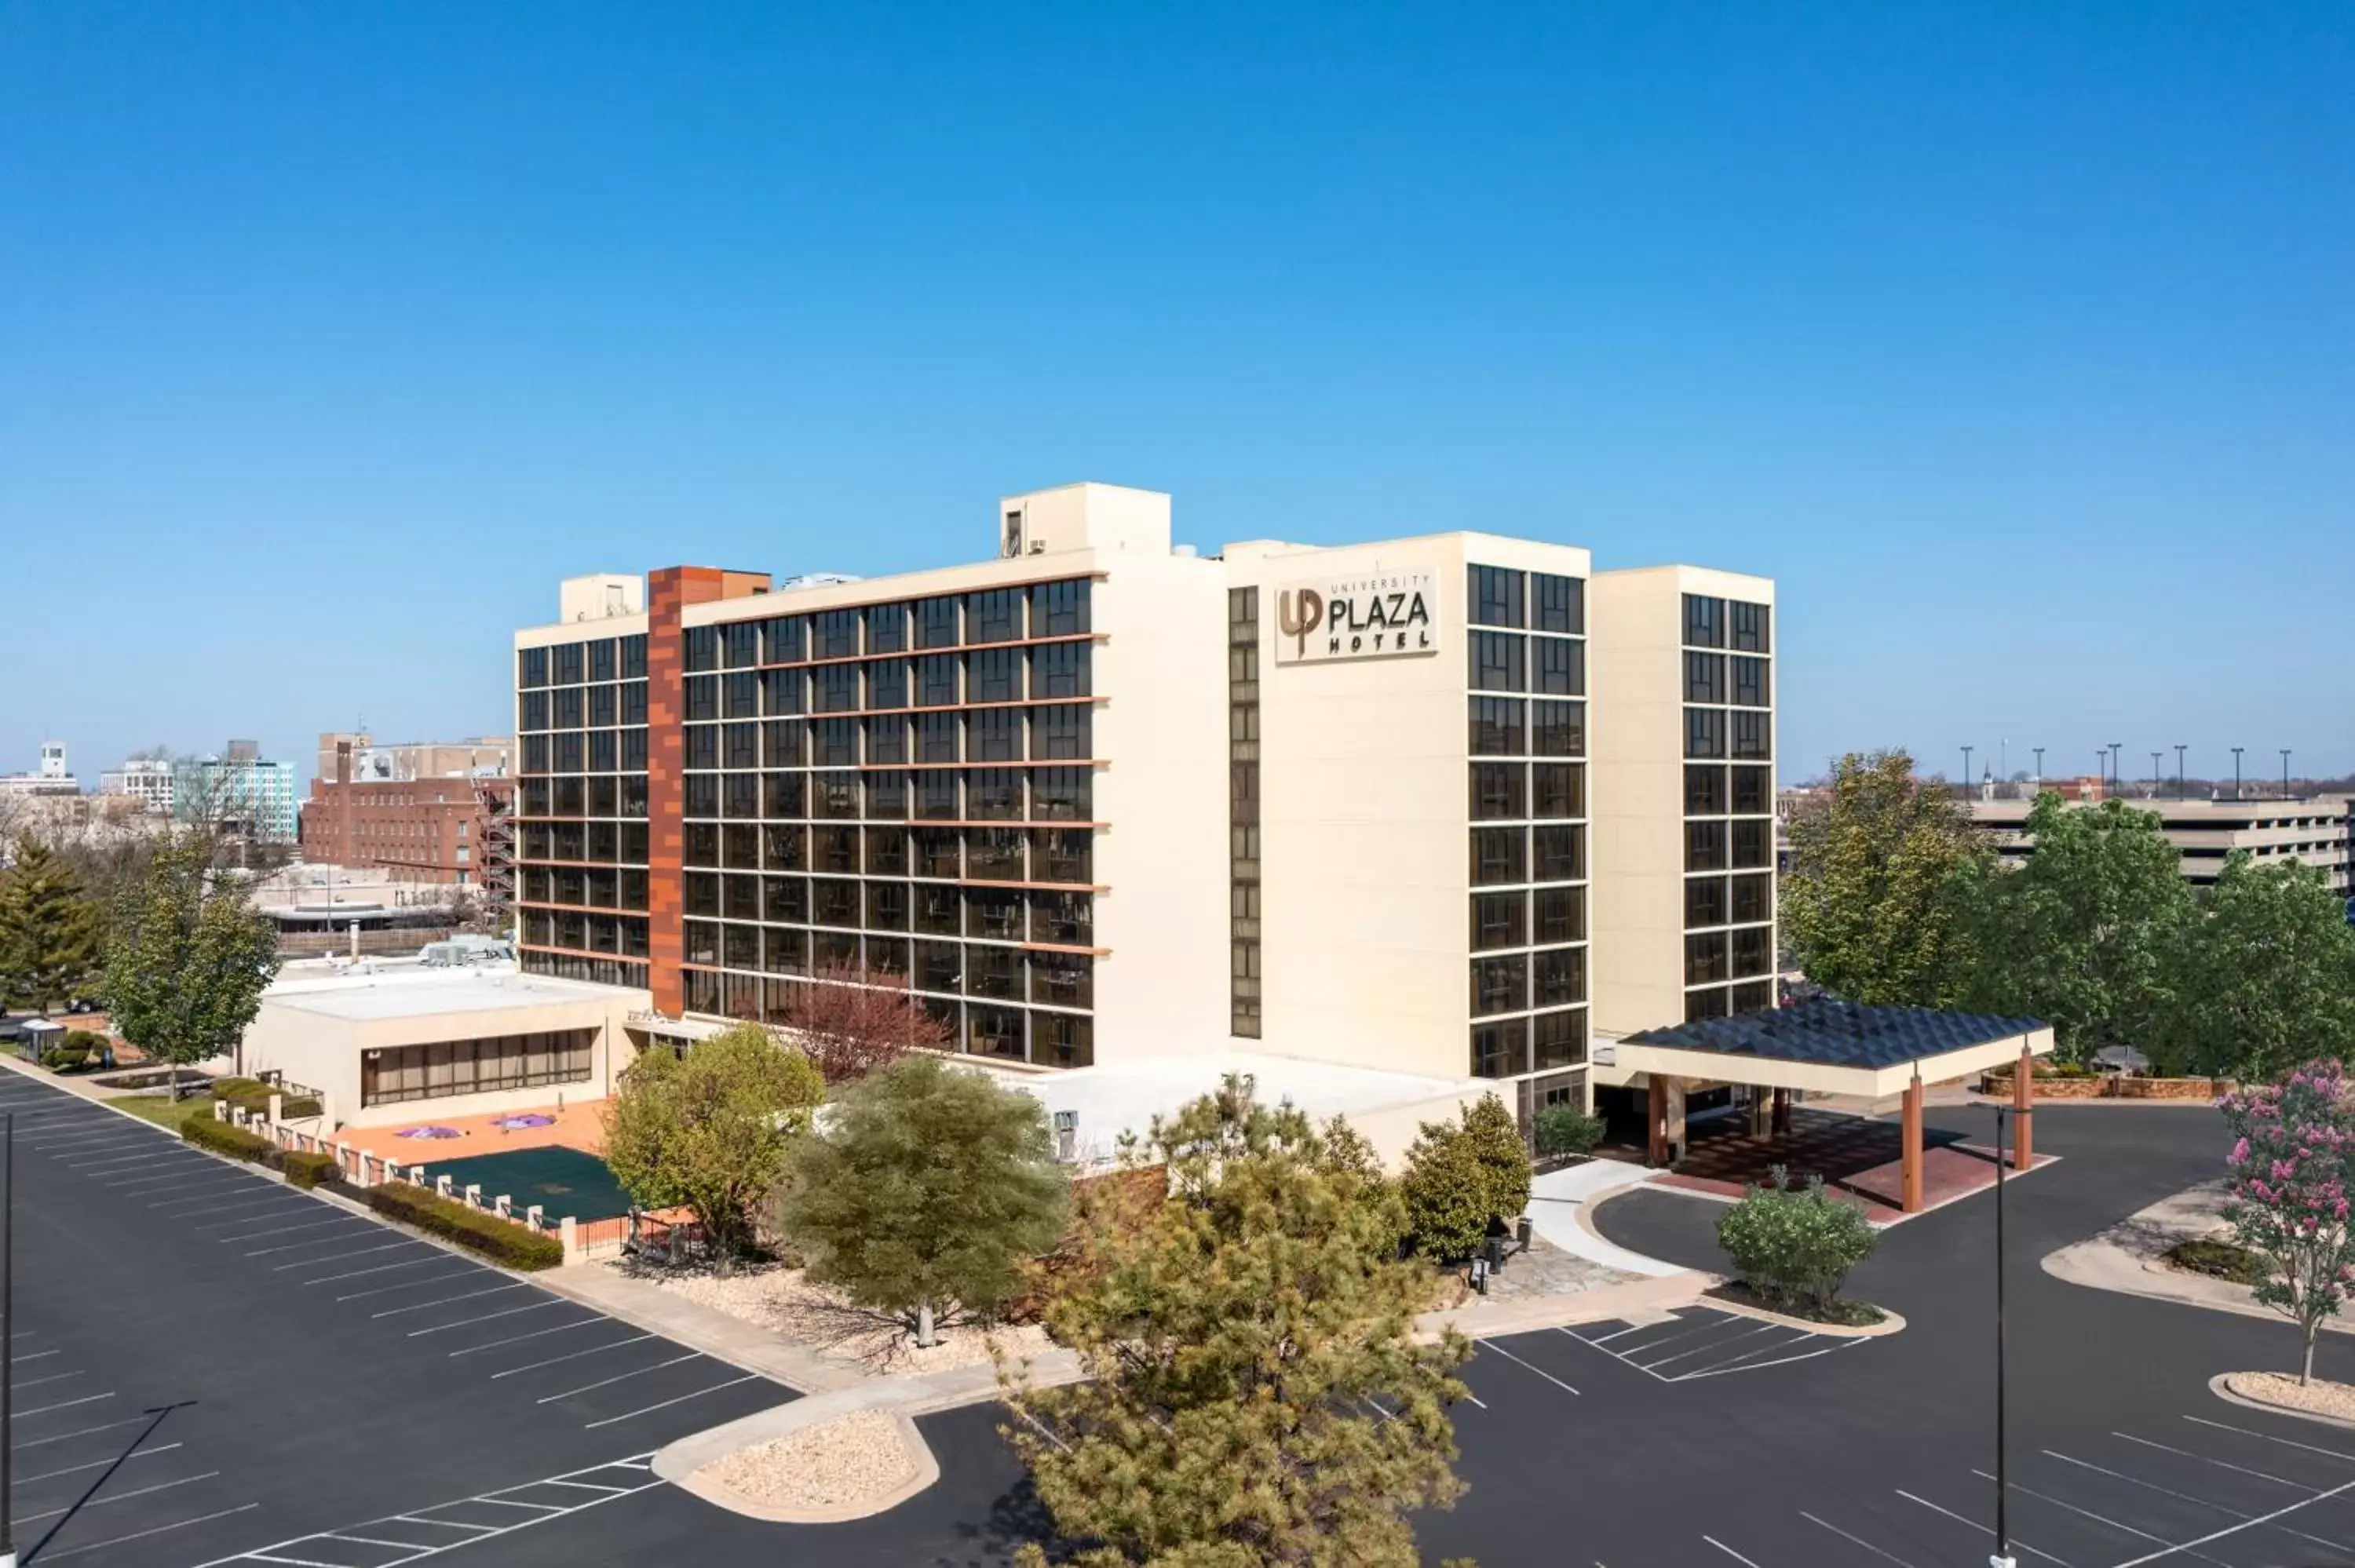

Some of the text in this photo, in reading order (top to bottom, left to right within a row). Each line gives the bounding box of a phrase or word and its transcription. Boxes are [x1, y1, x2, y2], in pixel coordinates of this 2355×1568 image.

[1331, 575, 1429, 594] UNIVERSITY
[1329, 592, 1429, 633] PLAZA
[1330, 631, 1429, 655] HOTEL
